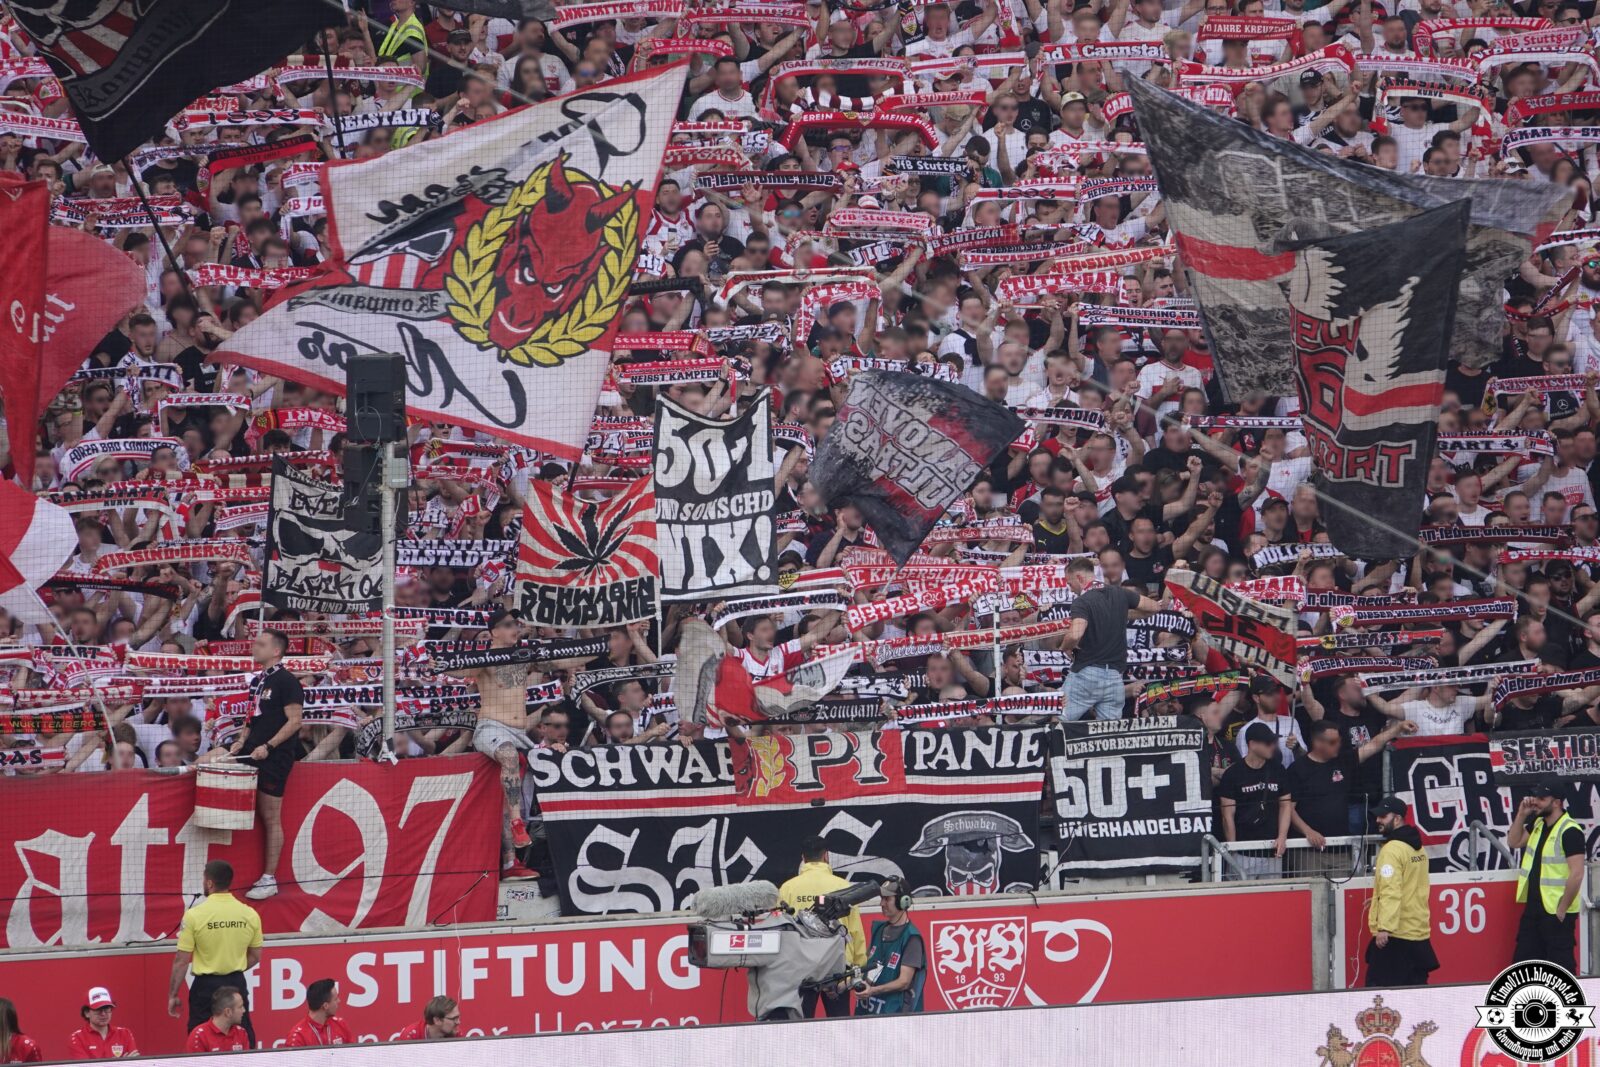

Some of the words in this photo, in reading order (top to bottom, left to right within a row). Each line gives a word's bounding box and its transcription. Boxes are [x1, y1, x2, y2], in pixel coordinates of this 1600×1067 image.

[1212, 23, 1243, 33] JAHRE
[1500, 36, 1519, 48] VfB
[1524, 33, 1581, 46] Stuttgart
[206, 110, 301, 125] 1893
[802, 113, 833, 122] EREIN
[880, 114, 914, 123] MEINE
[862, 213, 928, 227] Stuttgart
[942, 229, 1004, 248] STUTTGART
[614, 336, 692, 345] Stuttgart
[631, 371, 667, 384] HEISST
[69, 444, 99, 463] FORZA
[101, 440, 122, 453] BAD
[680, 490, 775, 521] SONSCHD
[160, 675, 246, 687] VERBANNTE
[897, 703, 970, 722] SCHWABEN
[994, 693, 1063, 712] KOMPANIE
[1088, 720, 1129, 735] EHRE
[1130, 715, 1178, 732] ALLEN
[1067, 736, 1157, 756] VERSTORBENEN
[1158, 732, 1201, 747] ULTRAS
[1050, 750, 1213, 820] 50+1
[943, 819, 998, 834] Schwaben
[292, 771, 474, 932] 97
[1438, 887, 1486, 935] 36
[206, 920, 248, 931] SECURITY
[345, 938, 701, 1008] STIFTUNG
[955, 974, 966, 985] 18
[993, 972, 1005, 983] 93
